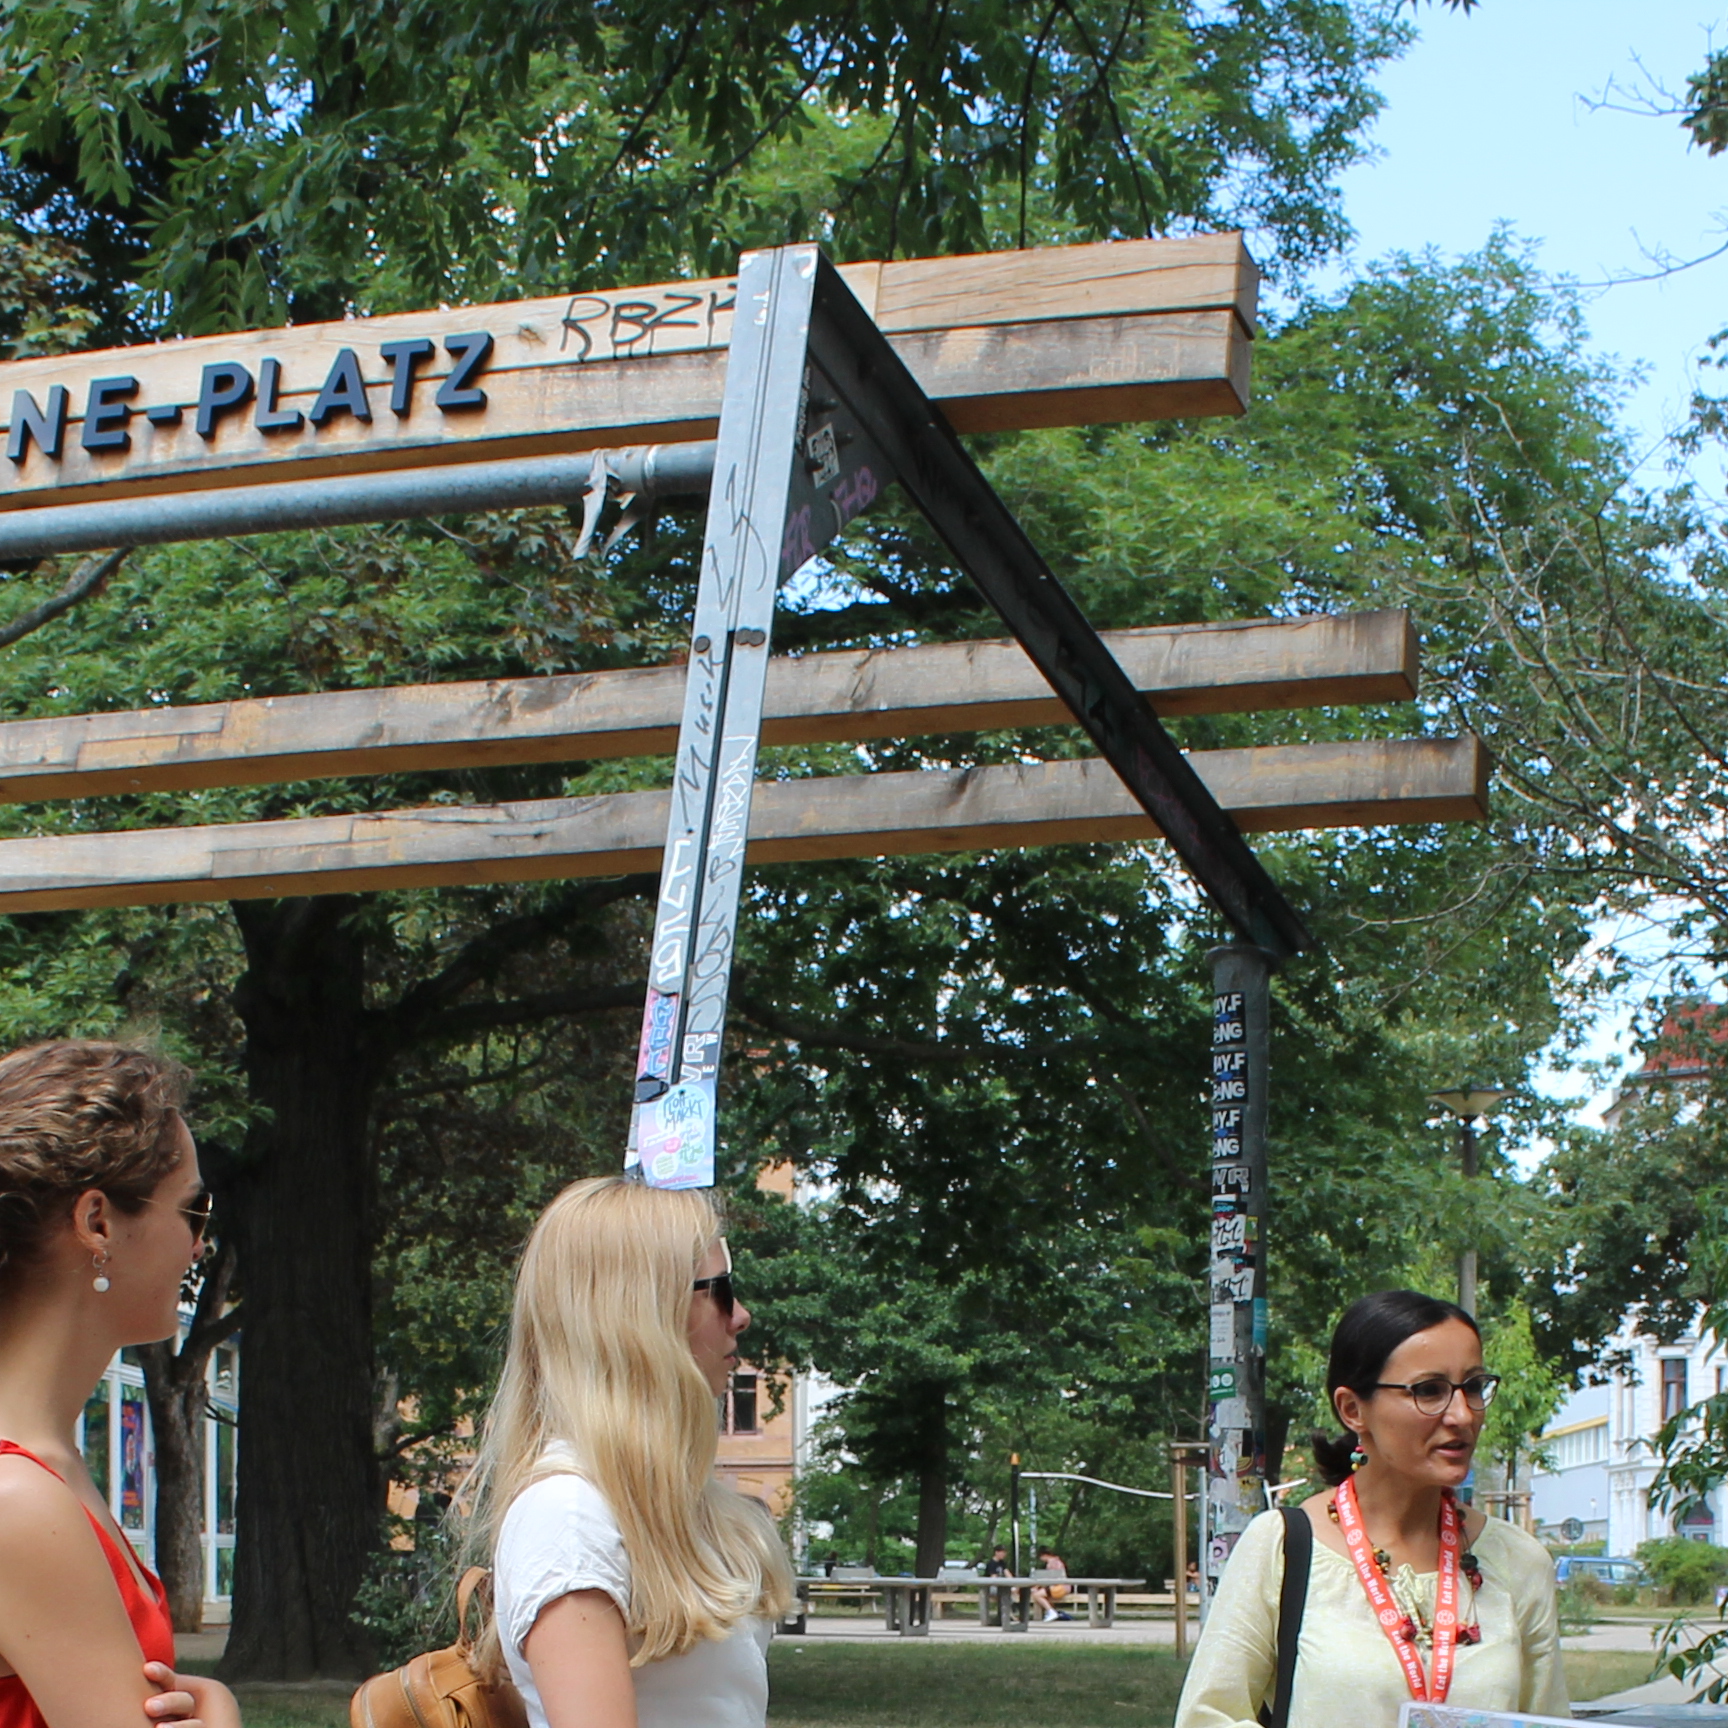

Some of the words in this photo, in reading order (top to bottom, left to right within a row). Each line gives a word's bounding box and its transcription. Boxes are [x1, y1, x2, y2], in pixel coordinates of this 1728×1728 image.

[1354, 1548, 1365, 1563] Eat
[1442, 1550, 1454, 1575] World
[1359, 1562, 1371, 1578] the
[1367, 1577, 1387, 1605] World
[1442, 1575, 1453, 1590] the
[1441, 1590, 1453, 1605] Eat
[1438, 1630, 1450, 1657] World
[1398, 1643, 1411, 1661] the
[1406, 1659, 1423, 1689] World
[1436, 1656, 1449, 1674] the
[1435, 1673, 1447, 1691] Eat
